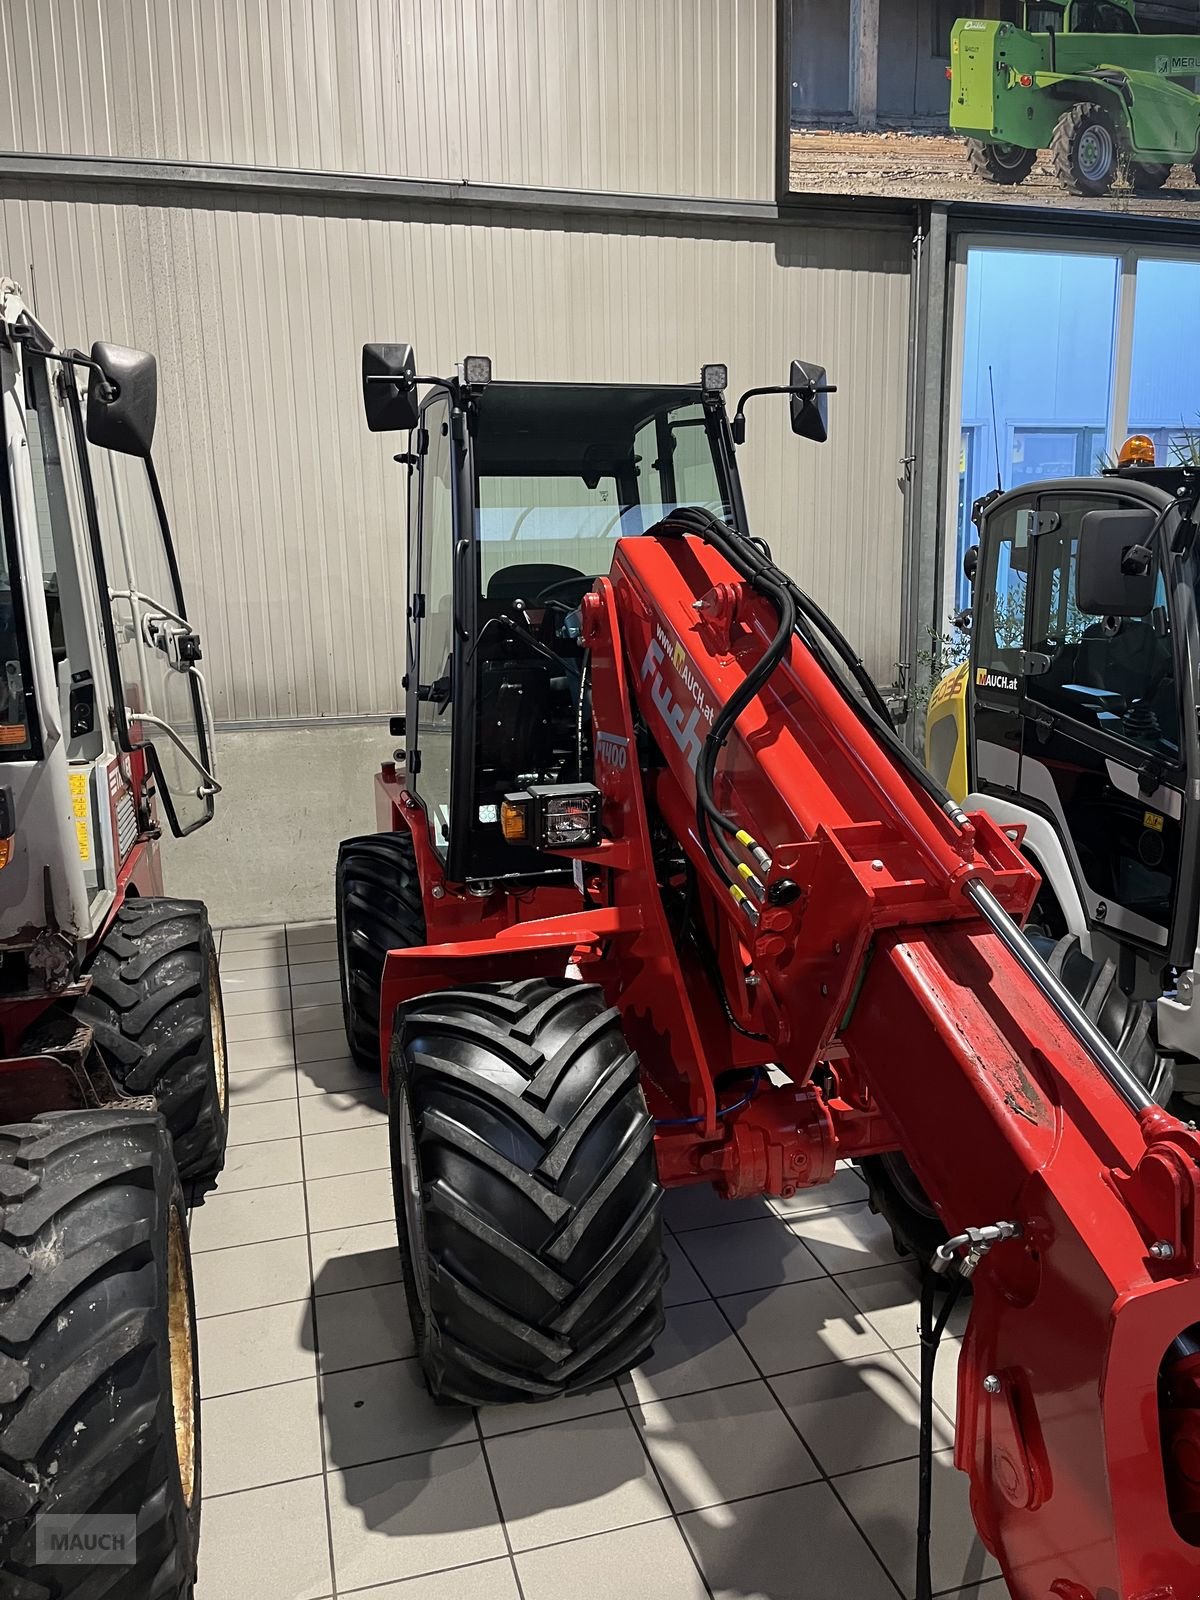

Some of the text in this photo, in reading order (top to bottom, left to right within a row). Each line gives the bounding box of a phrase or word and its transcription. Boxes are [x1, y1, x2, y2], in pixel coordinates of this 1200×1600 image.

[641, 638, 713, 783] Fuch
[656, 623, 715, 726] www.MAUCH.at
[977, 669, 1018, 691] MAUCH.at
